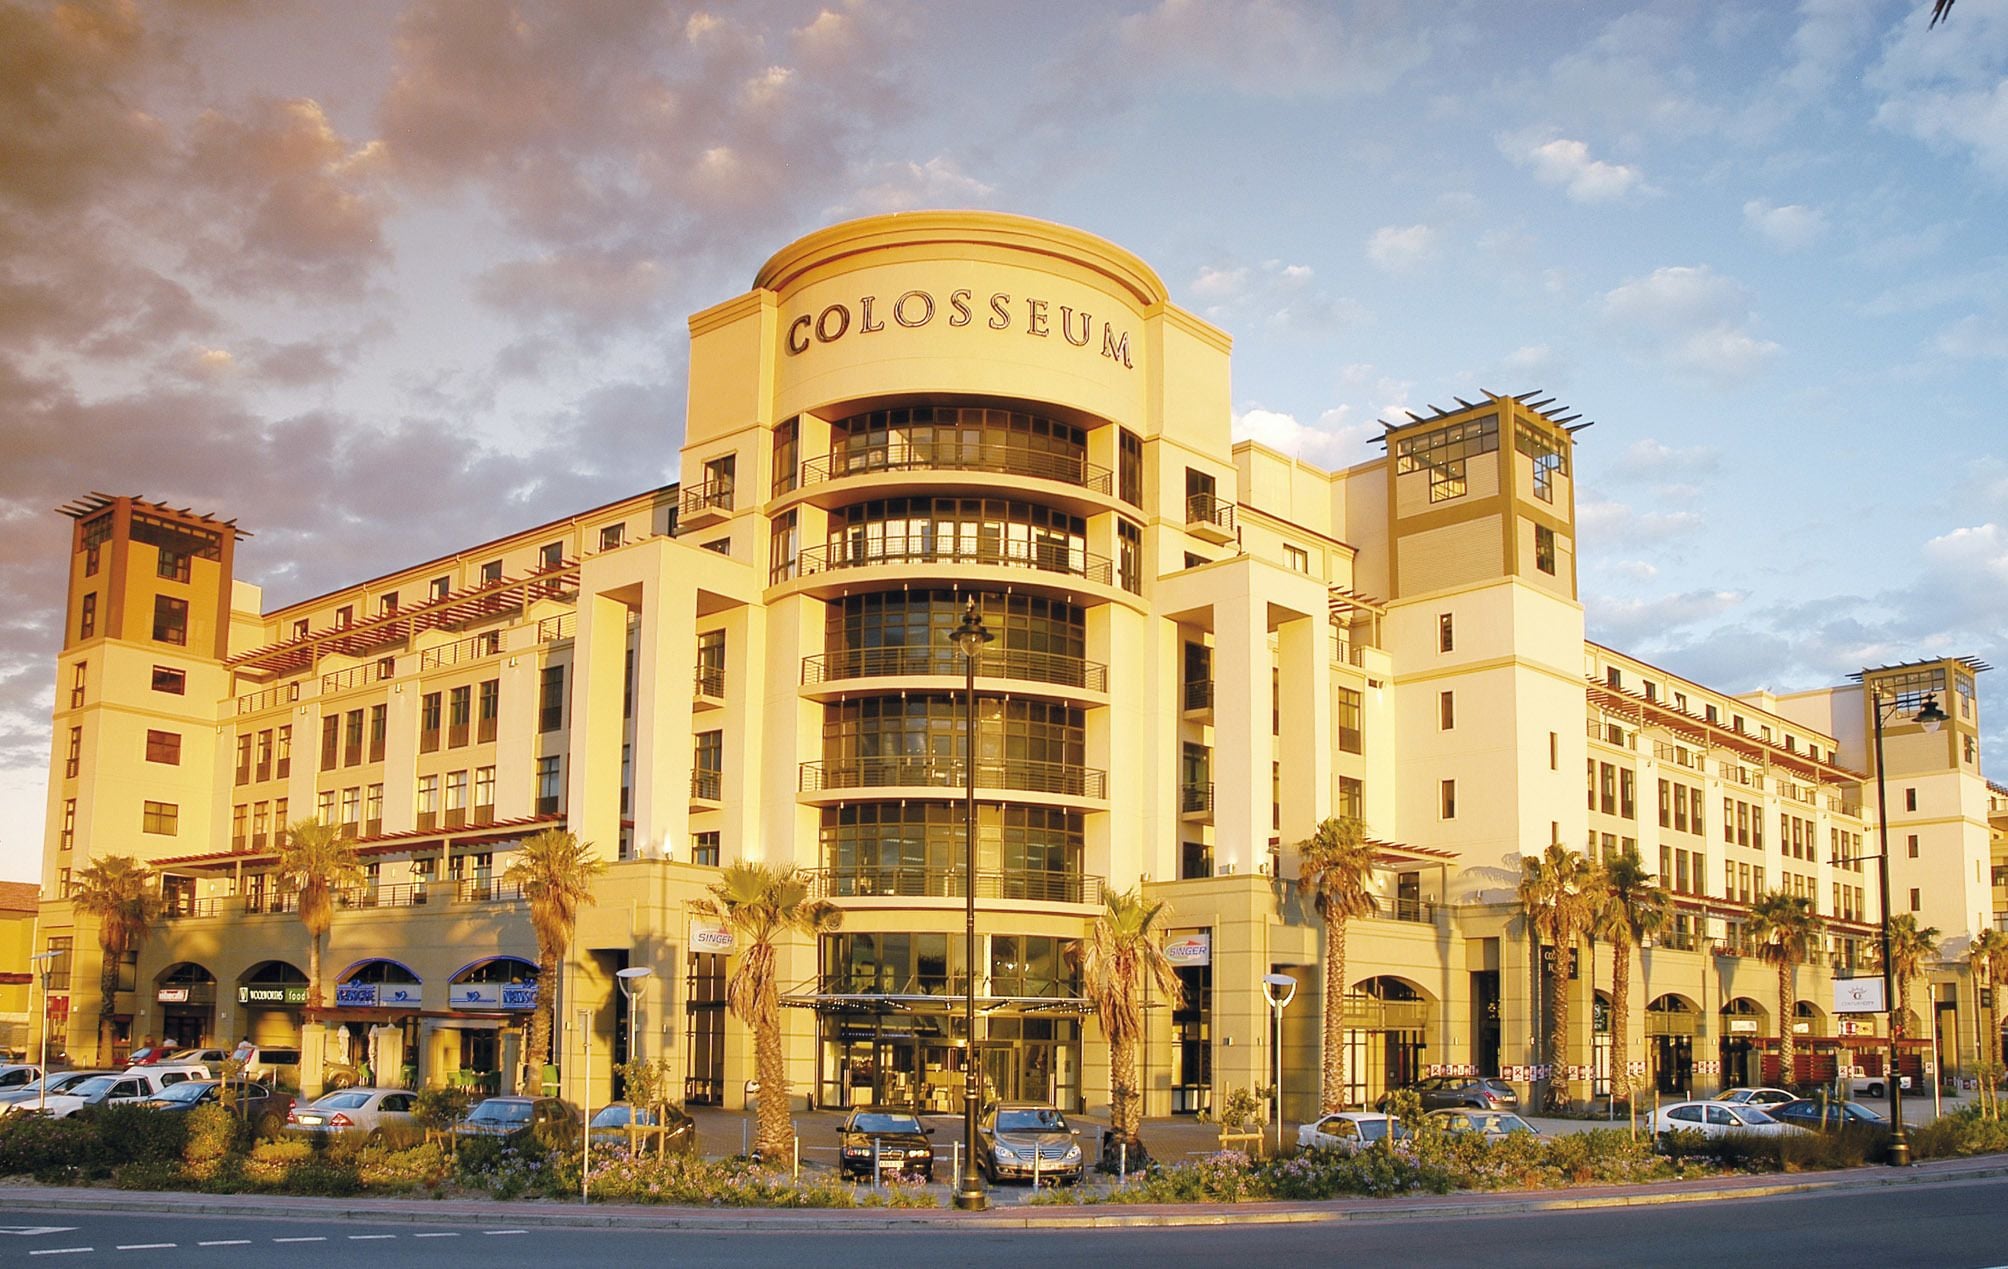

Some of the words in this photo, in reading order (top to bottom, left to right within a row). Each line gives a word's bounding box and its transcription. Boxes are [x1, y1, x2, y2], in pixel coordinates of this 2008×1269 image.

[786, 288, 1134, 370] COLOSSEUM
[698, 933, 734, 944] SINGER
[1170, 946, 1207, 956] SINGER
